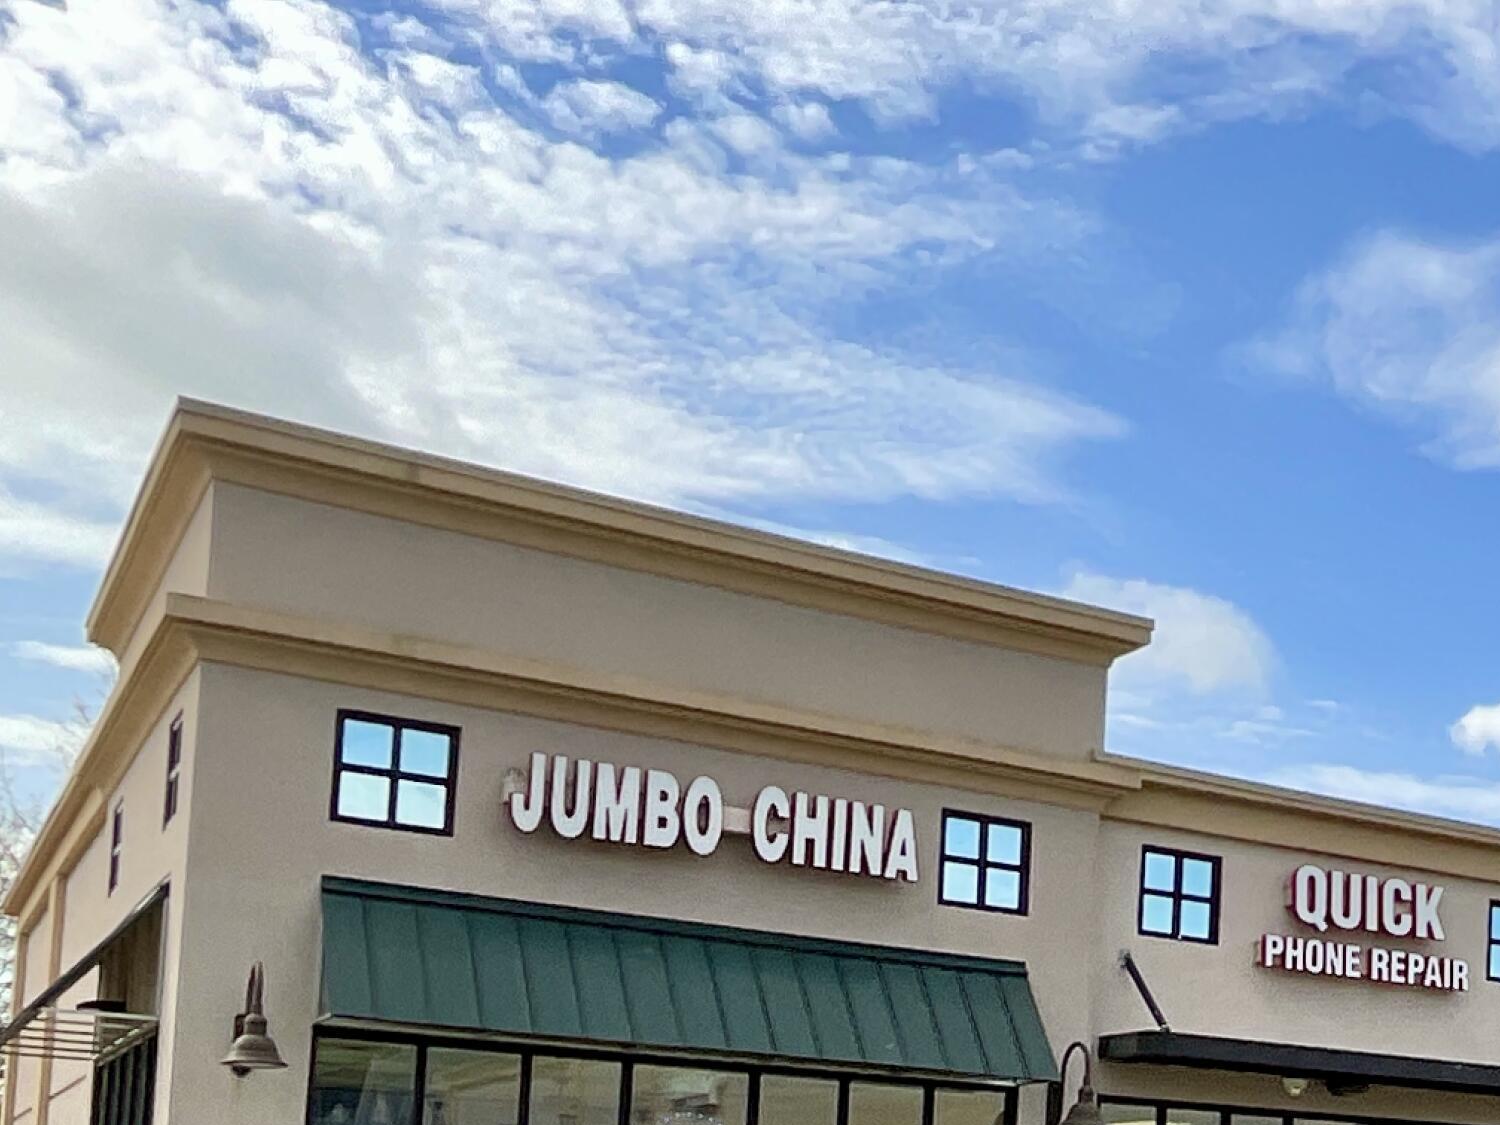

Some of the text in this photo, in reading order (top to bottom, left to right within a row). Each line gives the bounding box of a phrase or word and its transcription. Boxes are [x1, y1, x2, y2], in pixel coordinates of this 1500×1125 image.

[510, 752, 919, 883] JUMBO CHINA
[1293, 863, 1446, 942] QUICK
[1263, 933, 1470, 992] PHONE REPAIR
